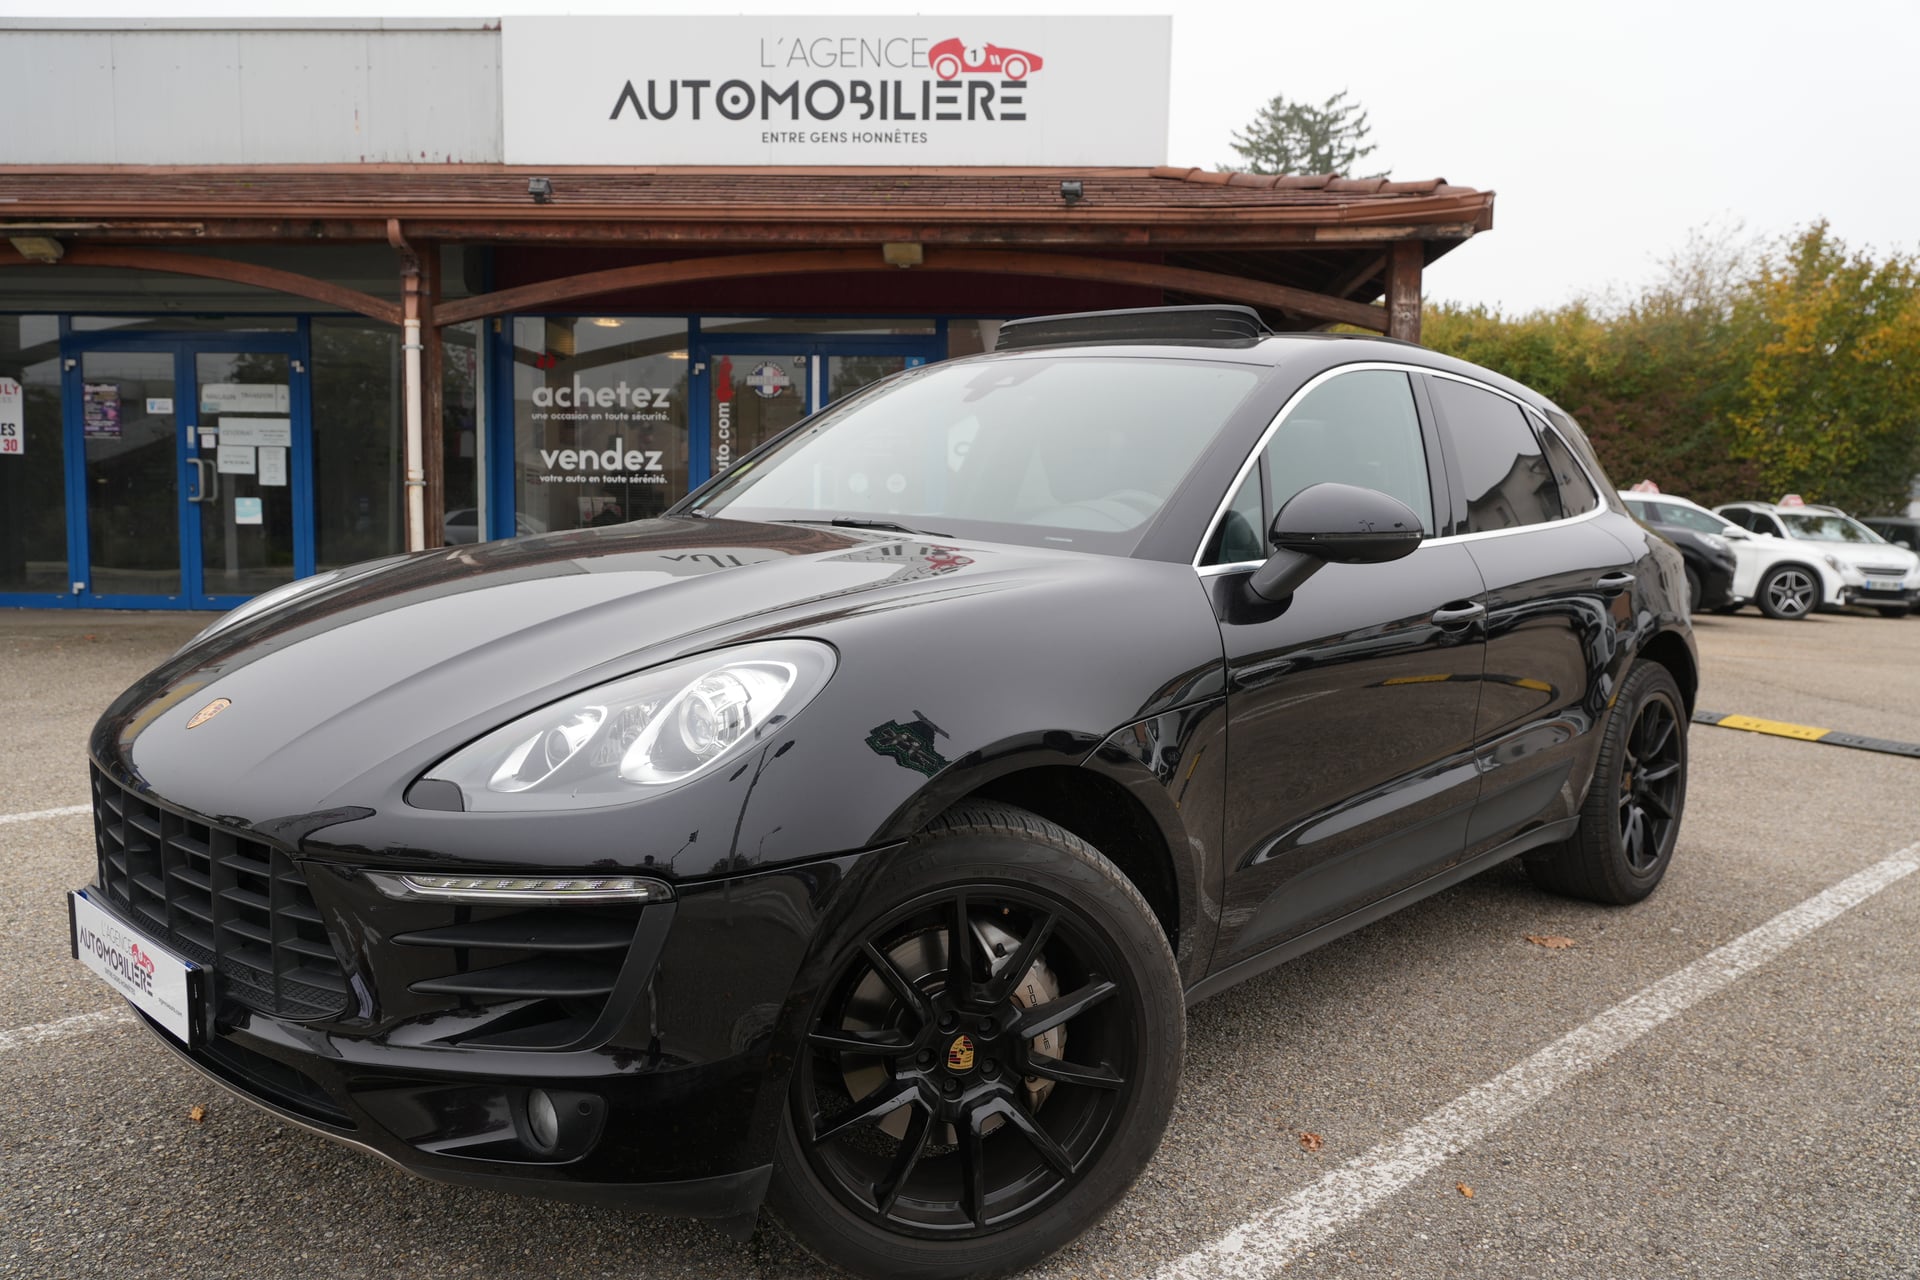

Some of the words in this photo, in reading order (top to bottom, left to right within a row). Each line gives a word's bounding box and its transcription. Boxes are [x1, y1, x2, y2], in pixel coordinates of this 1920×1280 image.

[609, 79, 1028, 121] AUTOMOBILIERE
[761, 131, 806, 144] ENTRE
[810, 131, 848, 144] GENS
[852, 128, 928, 144] HONNÊTES
[532, 373, 671, 408] achetez
[531, 412, 548, 420] une
[550, 410, 589, 420] occasion
[590, 412, 603, 420] en
[604, 411, 630, 420] toute
[631, 411, 670, 421] sécurité.
[3, 438, 18, 452] 30
[540, 437, 663, 471] vendez
[540, 474, 563, 483] votre
[565, 475, 587, 483] auto
[602, 475, 627, 483] toute
[629, 474, 668, 484] sérénité.
